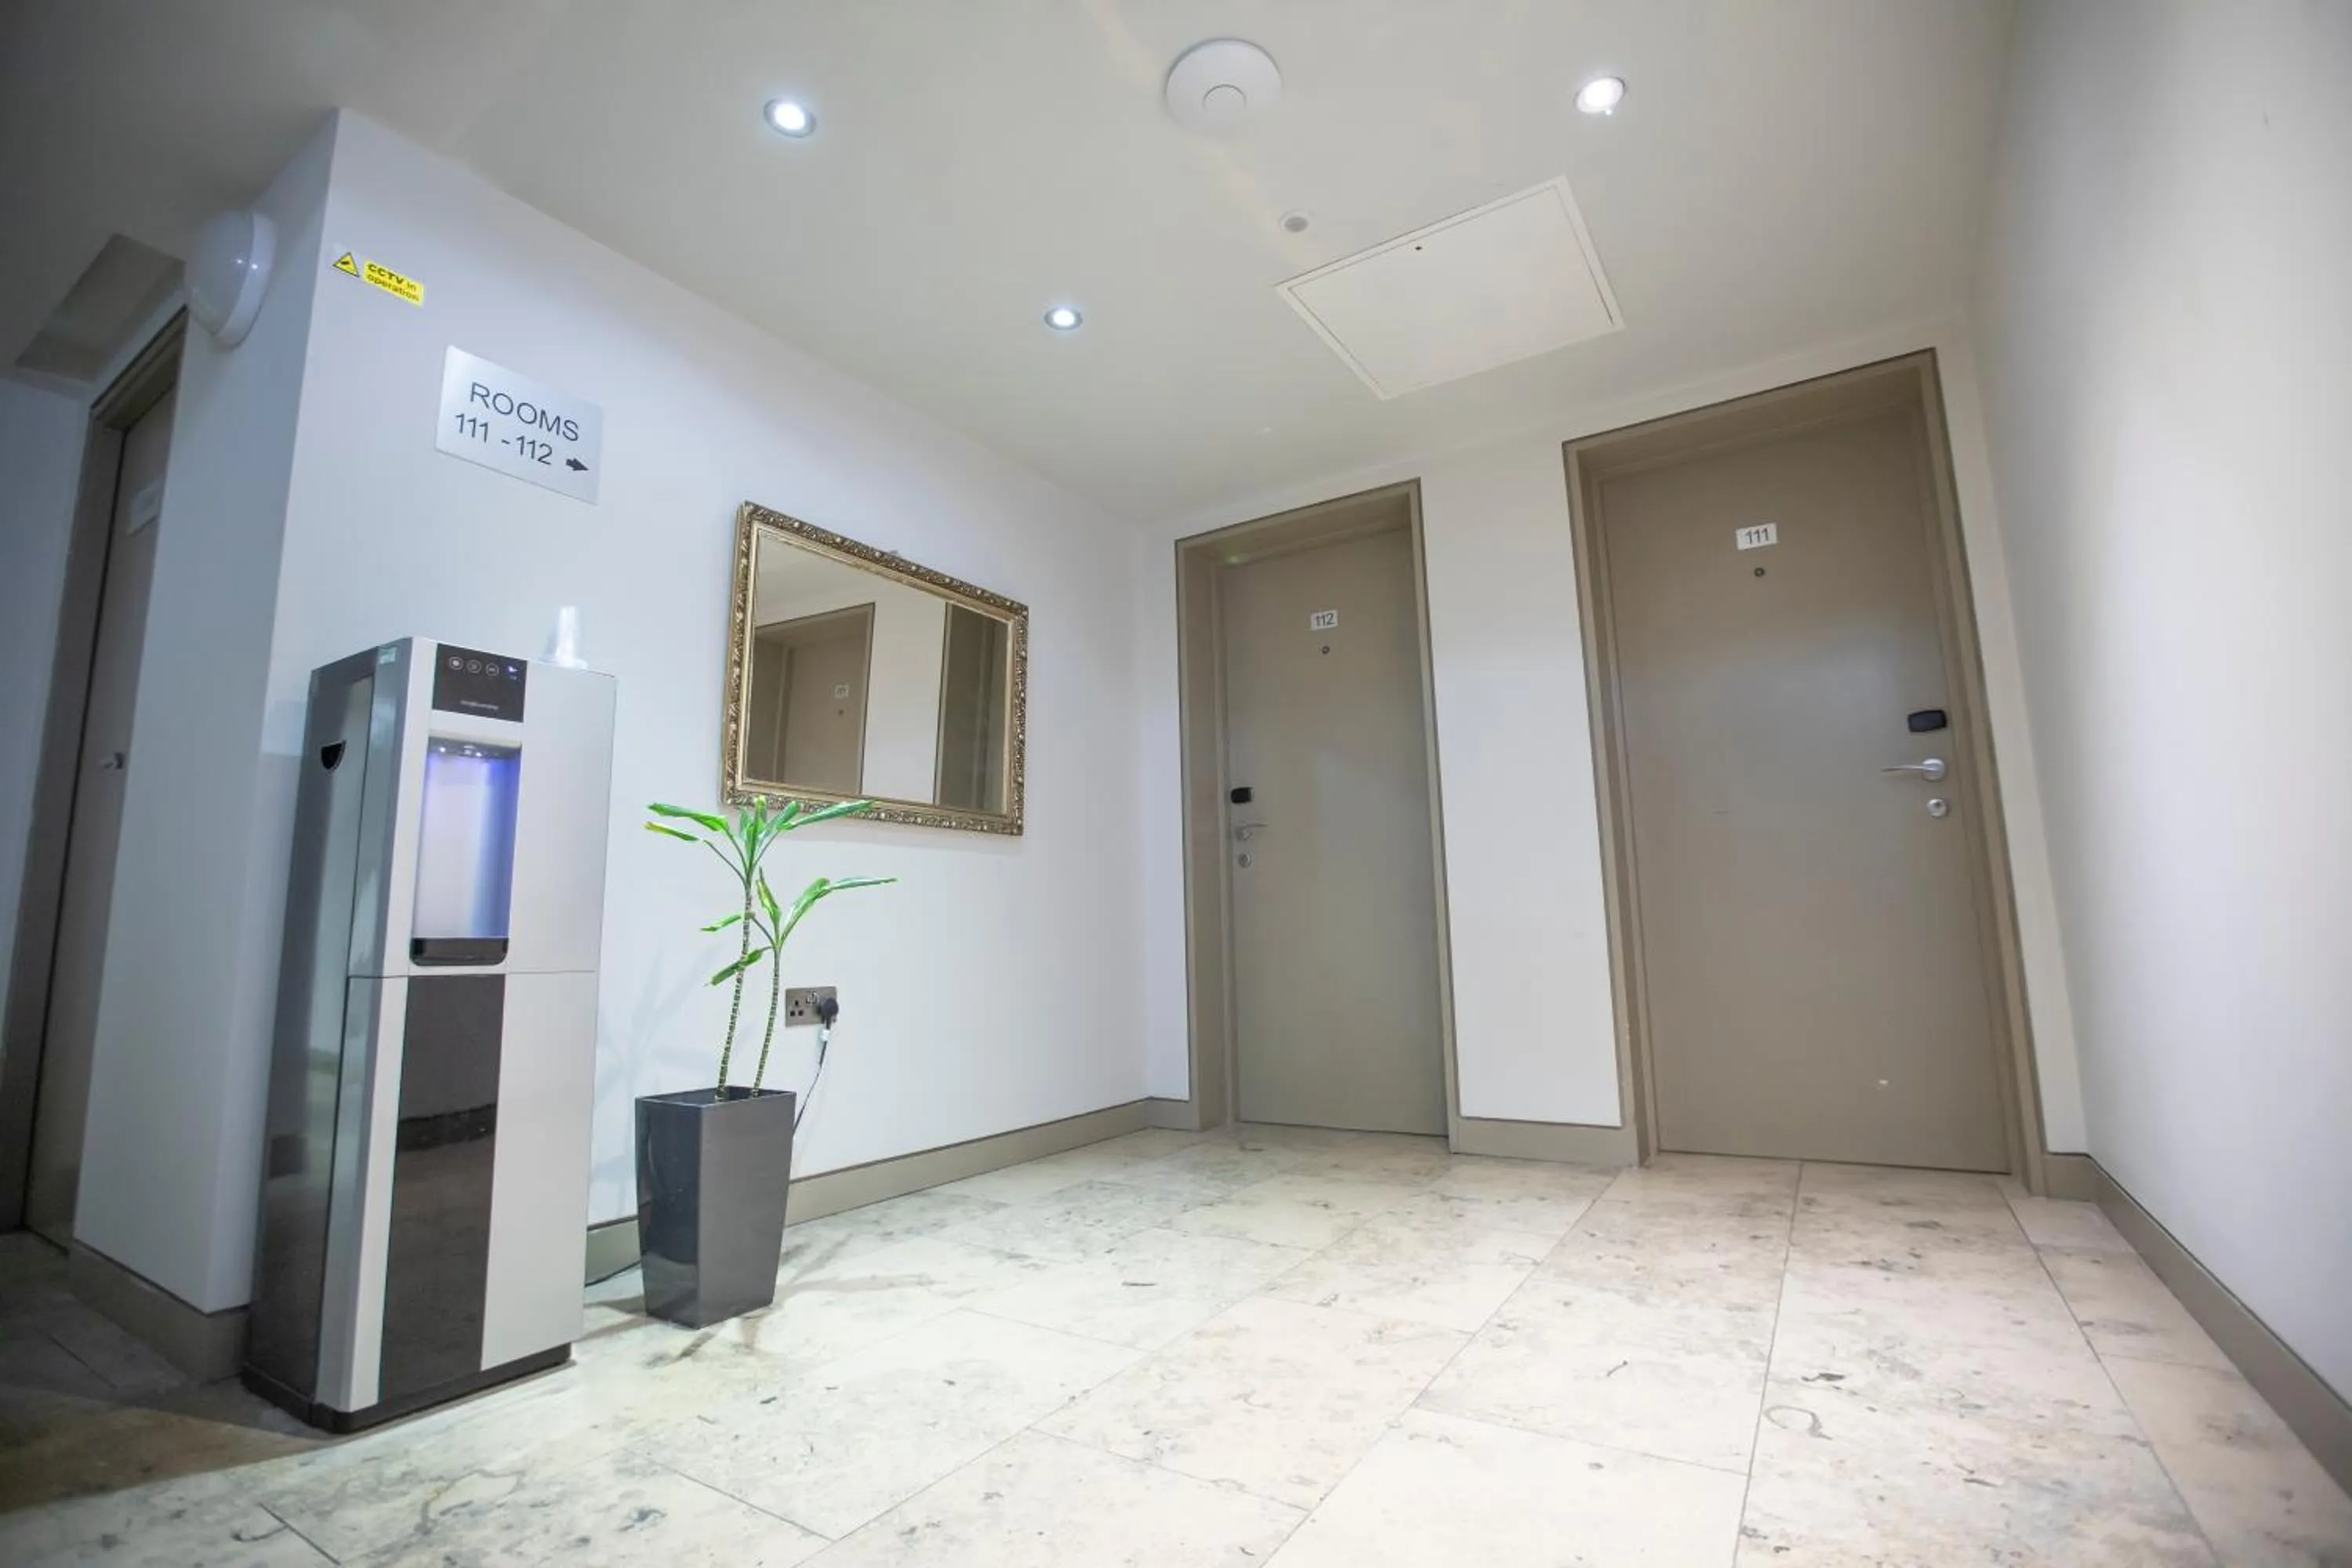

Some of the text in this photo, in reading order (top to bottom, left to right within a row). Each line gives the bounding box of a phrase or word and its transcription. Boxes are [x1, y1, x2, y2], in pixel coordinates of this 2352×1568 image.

[367, 263, 405, 285] CCTV
[366, 273, 419, 302] operation
[470, 381, 580, 442] ROOMS
[455, 412, 490, 443] 111
[1744, 526, 1769, 546] 111
[1316, 612, 1337, 627] 112
